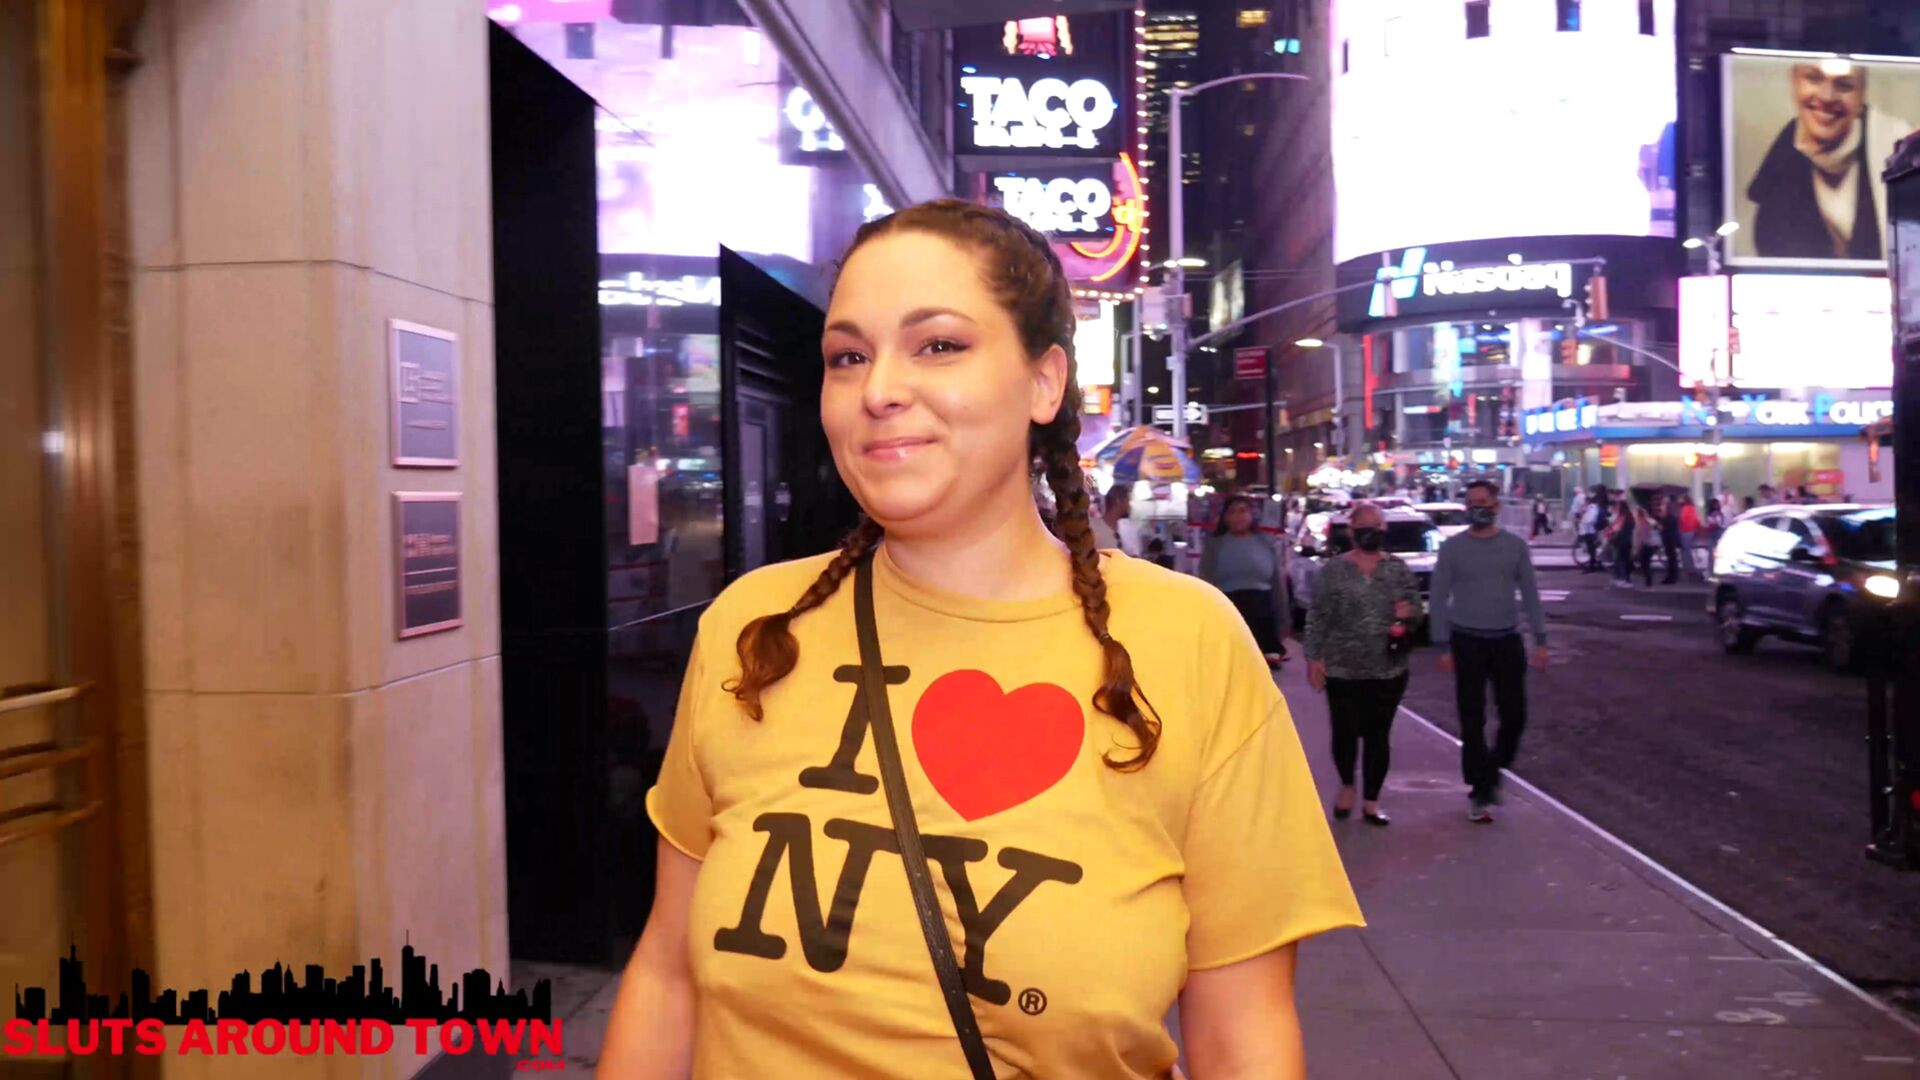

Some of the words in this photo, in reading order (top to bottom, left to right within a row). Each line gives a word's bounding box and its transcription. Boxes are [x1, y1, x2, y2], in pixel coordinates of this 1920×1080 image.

[961, 76, 1114, 131] TACO
[994, 177, 1111, 219] TACO
[1423, 253, 1572, 298] Nasdaq
[799, 664, 911, 795] I
